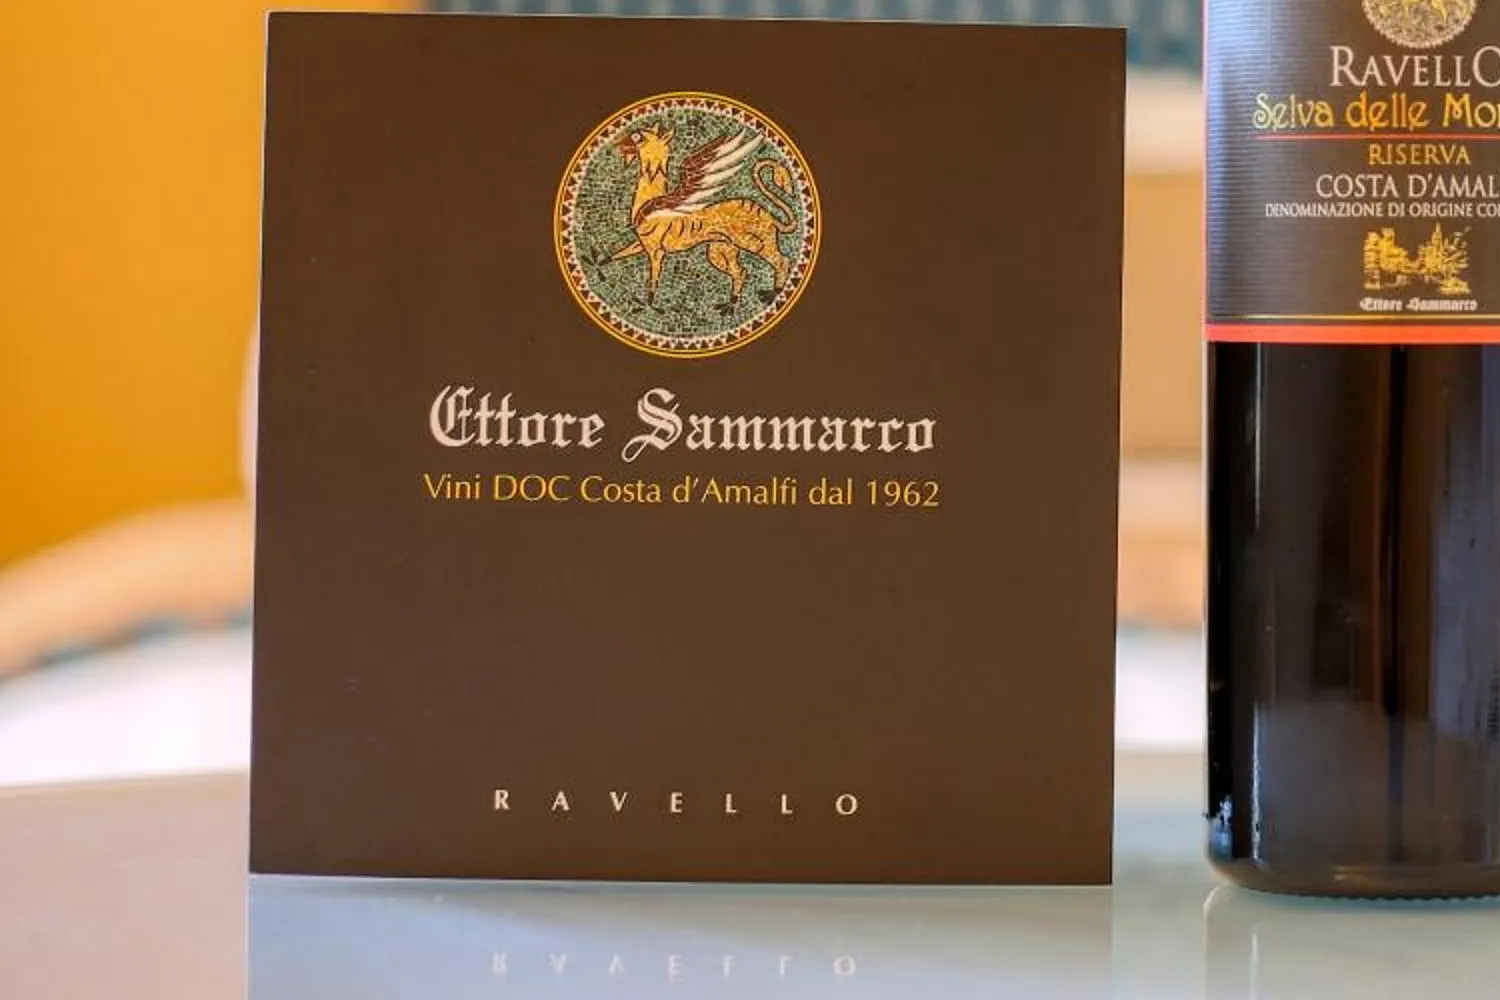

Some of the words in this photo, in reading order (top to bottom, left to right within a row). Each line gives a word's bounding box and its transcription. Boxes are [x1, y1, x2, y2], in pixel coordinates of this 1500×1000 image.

[1252, 92, 1334, 132] Selva
[1346, 90, 1430, 131] delle
[1368, 144, 1471, 165] RISERVA
[1316, 173, 1400, 198] COSTA
[1265, 202, 1384, 217] DENOMINAZIONE
[1388, 203, 1404, 217] DI
[1409, 202, 1473, 217] ORIGINE
[430, 385, 604, 447] Ettore
[621, 387, 936, 463] Sammarco
[423, 473, 482, 500] Vini
[493, 474, 571, 503] DOC
[580, 476, 662, 504] Costa
[672, 475, 797, 506] d'Amalfi
[808, 478, 853, 507] dal
[867, 480, 939, 508] 1962
[494, 789, 858, 816] RAVELLO
